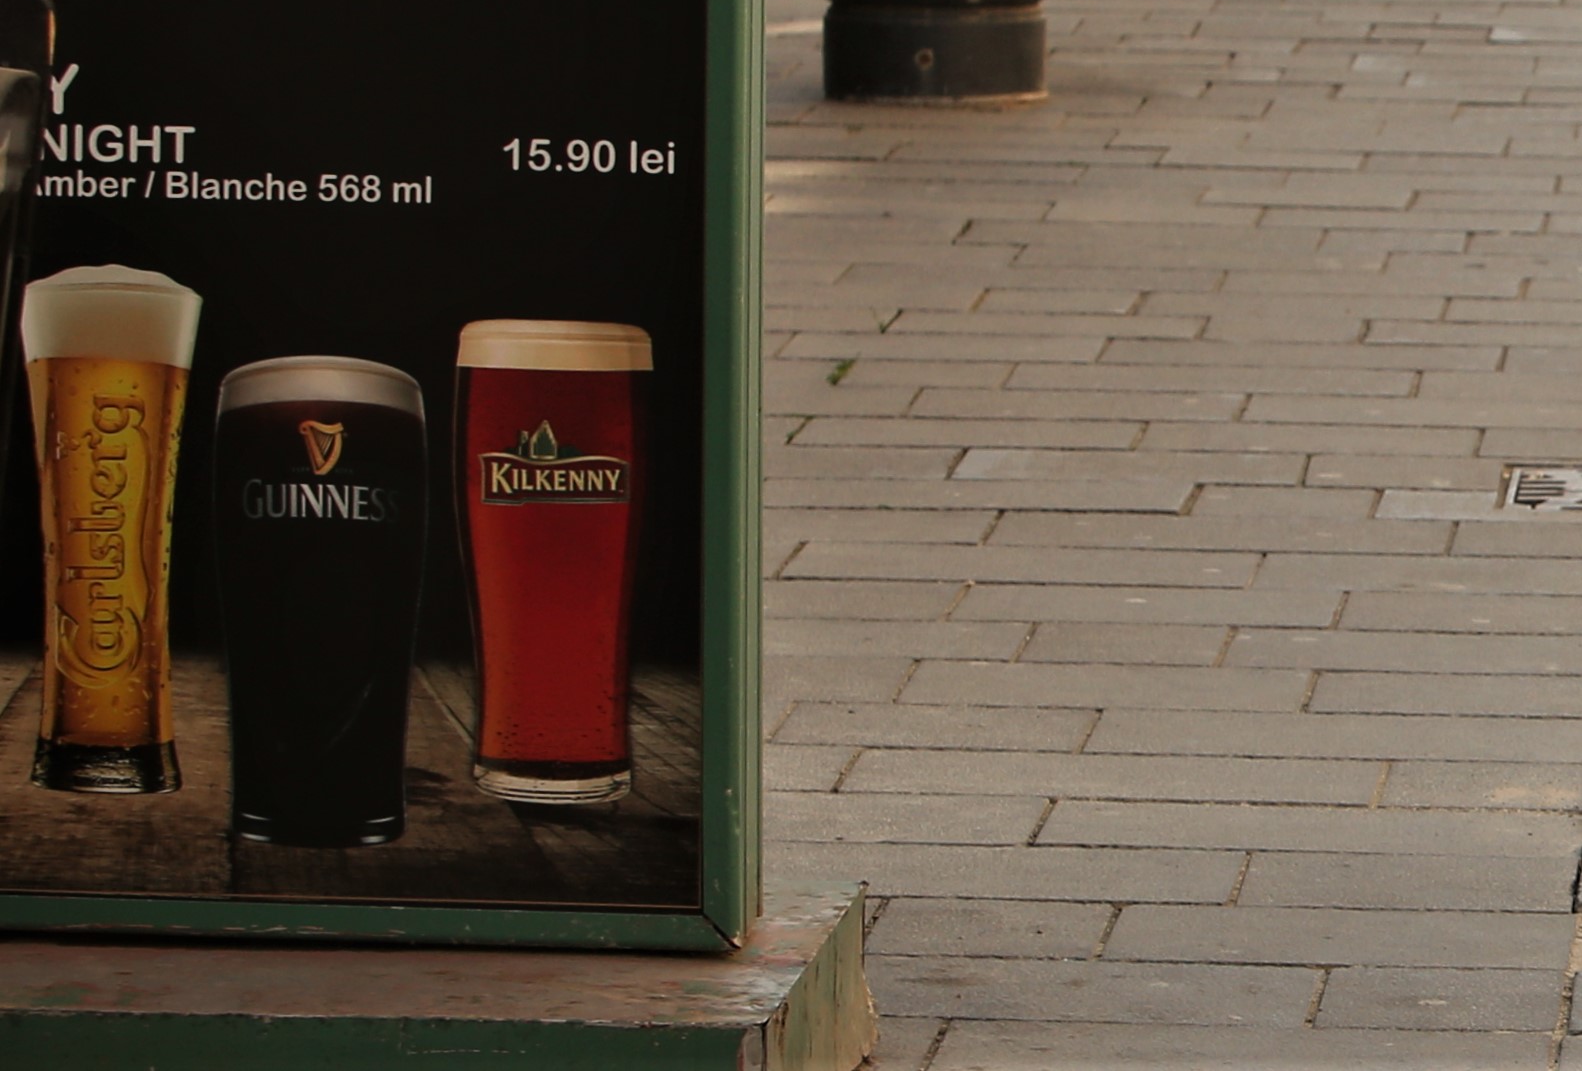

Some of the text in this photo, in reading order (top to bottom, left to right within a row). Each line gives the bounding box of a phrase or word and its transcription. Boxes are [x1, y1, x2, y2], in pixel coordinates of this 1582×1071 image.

[40, 123, 196, 165] NIGHT
[501, 137, 677, 175] 15.90 lei
[36, 169, 137, 199] mber
[165, 171, 308, 203] Blanche
[318, 173, 383, 204] 568
[392, 175, 433, 205] ml
[55, 390, 147, 689] Carlsberg
